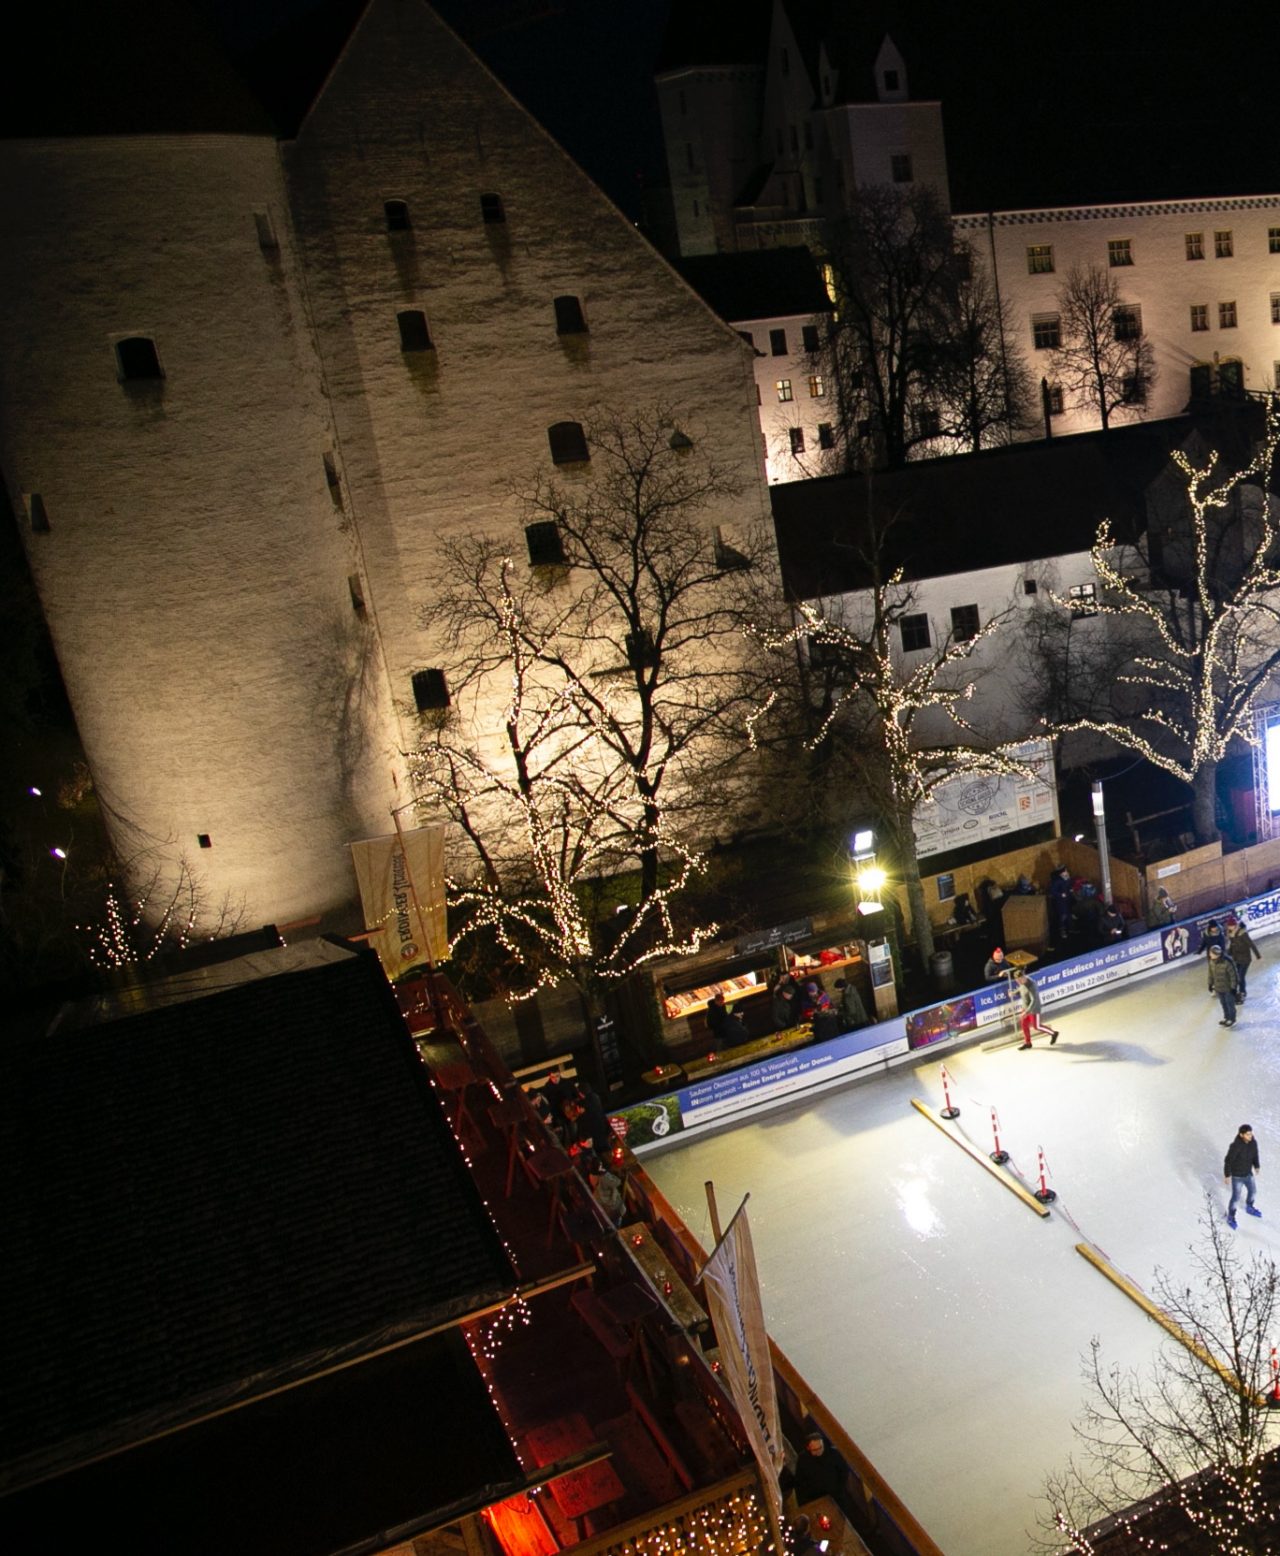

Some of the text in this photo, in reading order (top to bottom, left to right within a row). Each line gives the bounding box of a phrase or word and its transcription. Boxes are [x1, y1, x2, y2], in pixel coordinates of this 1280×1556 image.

[1048, 974, 1061, 984] zur
[1062, 962, 1095, 978] Eisdisco
[1096, 958, 1104, 968] in
[1105, 952, 1120, 964] der
[1056, 984, 1075, 996] 19:30
[1076, 980, 1086, 991] bis
[1087, 975, 1106, 988] 22:00
[742, 1078, 760, 1090] Reine
[762, 1070, 786, 1084] Energie
[786, 1066, 798, 1074] aus
[798, 1062, 810, 1072] der
[750, 1069, 760, 1078] 100
